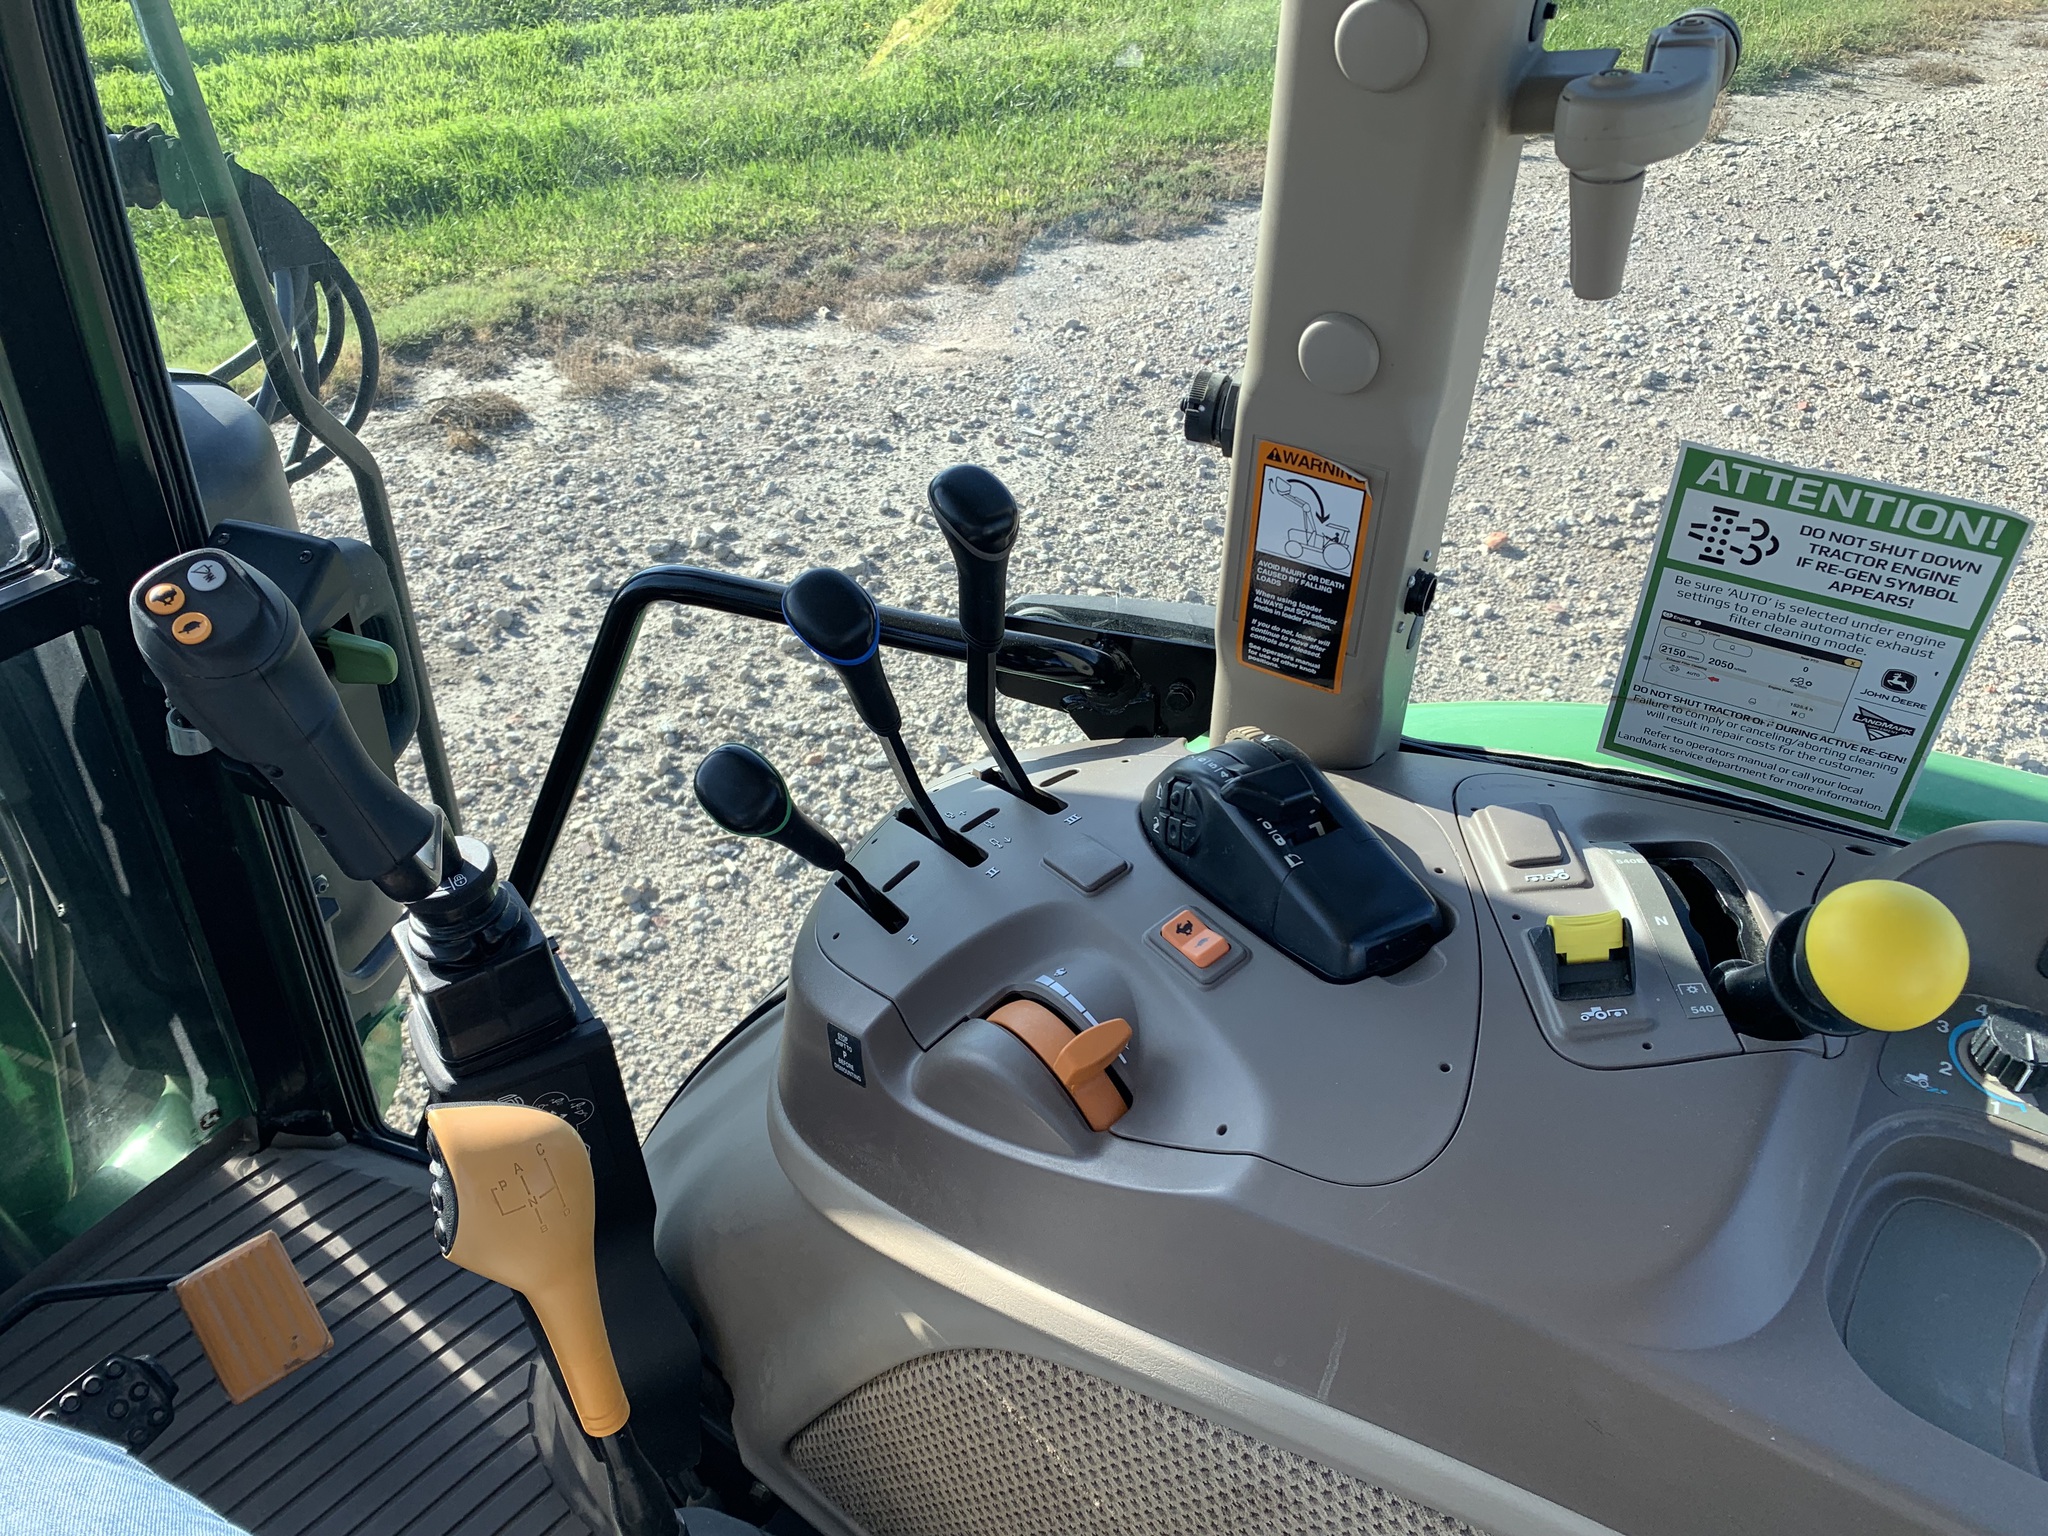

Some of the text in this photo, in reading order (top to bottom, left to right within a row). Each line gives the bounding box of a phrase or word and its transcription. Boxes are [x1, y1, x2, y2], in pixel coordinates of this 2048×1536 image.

[1282, 450, 1367, 484] WARNIN
[1695, 458, 2008, 550] ATTENTION!
[1798, 524, 1983, 574] DO NOT SHUT DOWN
[1257, 559, 1344, 590] AVOID INJURY OR DEATH
[1807, 542, 1962, 587] TRACTOR ENGINE
[1256, 573, 1281, 586] LOADS
[1257, 566, 1332, 594] CAUSED BY FALLING
[1795, 556, 1961, 603] IF RE-GEN SYMBOL
[1254, 588, 1322, 614] When using loader
[1827, 579, 1915, 609] APPEARS!
[1253, 595, 1337, 625] ALWAYS put SCV selector
[1253, 602, 1331, 632] knobs in loader position.
[1674, 574, 1692, 586] Be
[1694, 580, 1723, 594] sure
[1774, 599, 1786, 610] is
[1788, 602, 1848, 625] selected
[1850, 617, 1895, 636] under
[1894, 628, 1947, 651] engine
[1675, 587, 1936, 660] settings to enable automatic exhaust
[1249, 631, 1321, 659] controls are released.
[1250, 624, 1280, 639] continue
[1289, 637, 1308, 648] move
[1308, 643, 1326, 653] after
[1257, 620, 1270, 630] you
[1270, 623, 1280, 632] do
[1295, 631, 1316, 643] loader
[1317, 638, 1330, 647] will
[1727, 612, 1869, 656] filter cleaning mode.
[1248, 642, 1320, 670] See operators manual
[1258, 652, 1270, 660] use
[1280, 658, 1298, 669] other
[1299, 664, 1316, 674] knob
[1660, 644, 1686, 657] 2150
[1707, 657, 1734, 670] 2050
[1859, 687, 1928, 710] JOHN DEERE
[1632, 684, 1648, 694] DO
[1649, 688, 1672, 700] NOT
[1672, 695, 1702, 708] SHUT
[1701, 702, 1751, 721] TRACTOR
[1774, 722, 1818, 740] DURING
[1818, 734, 1859, 751] ACTIVE
[1859, 745, 1907, 764] RE-GEN!
[1632, 693, 1899, 775] Failure to comply or canceling/aborting cleaning
[1645, 708, 1877, 778] will result in repair costs for the customer.
[1617, 730, 1885, 812] LandMark service department for more information.
[1643, 726, 1863, 795] Refer to operators manual or call your local
[1654, 915, 1669, 926] N
[1690, 1005, 1715, 1015] 540
[1975, 1003, 1989, 1016] 4
[1936, 1020, 1950, 1034] 3
[1939, 1061, 1953, 1077] 2
[1990, 1101, 2000, 1115] 1
[535, 1142, 545, 1156] C
[513, 1162, 524, 1175] A
[498, 1179, 508, 1191] P
[528, 1196, 538, 1207] N
